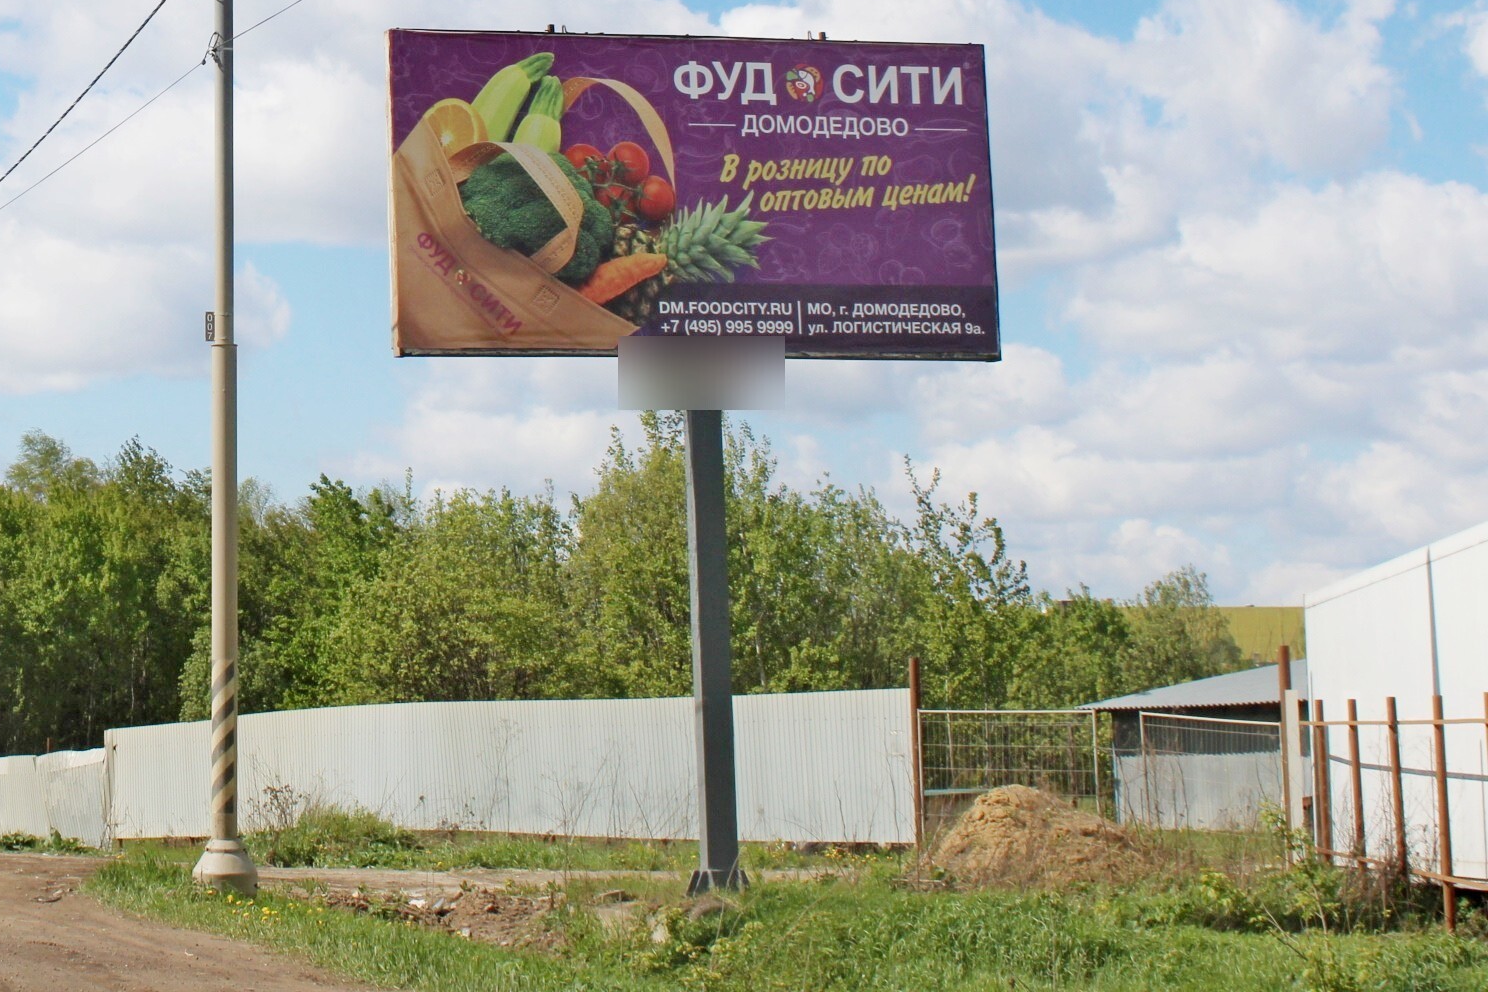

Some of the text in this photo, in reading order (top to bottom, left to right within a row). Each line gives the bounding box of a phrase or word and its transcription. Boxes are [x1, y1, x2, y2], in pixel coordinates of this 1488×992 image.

[673, 61, 963, 105] ФУД СИТИ
[741, 114, 909, 138] ДОМОДЕДОВО
[719, 154, 893, 191] В розницу по
[759, 173, 977, 212] оптовым ценам!
[417, 233, 456, 276] ФУД
[469, 283, 523, 335] СИТИ
[659, 301, 793, 316] DM.FOODCITY.RU
[807, 302, 966, 318] МО, г. ДОМОДЕДОВО,
[661, 319, 794, 336] +7 (495) 995 9999
[808, 323, 829, 336] ул.
[831, 321, 962, 334] ЛОГИСТИЧЕСКАЯ
